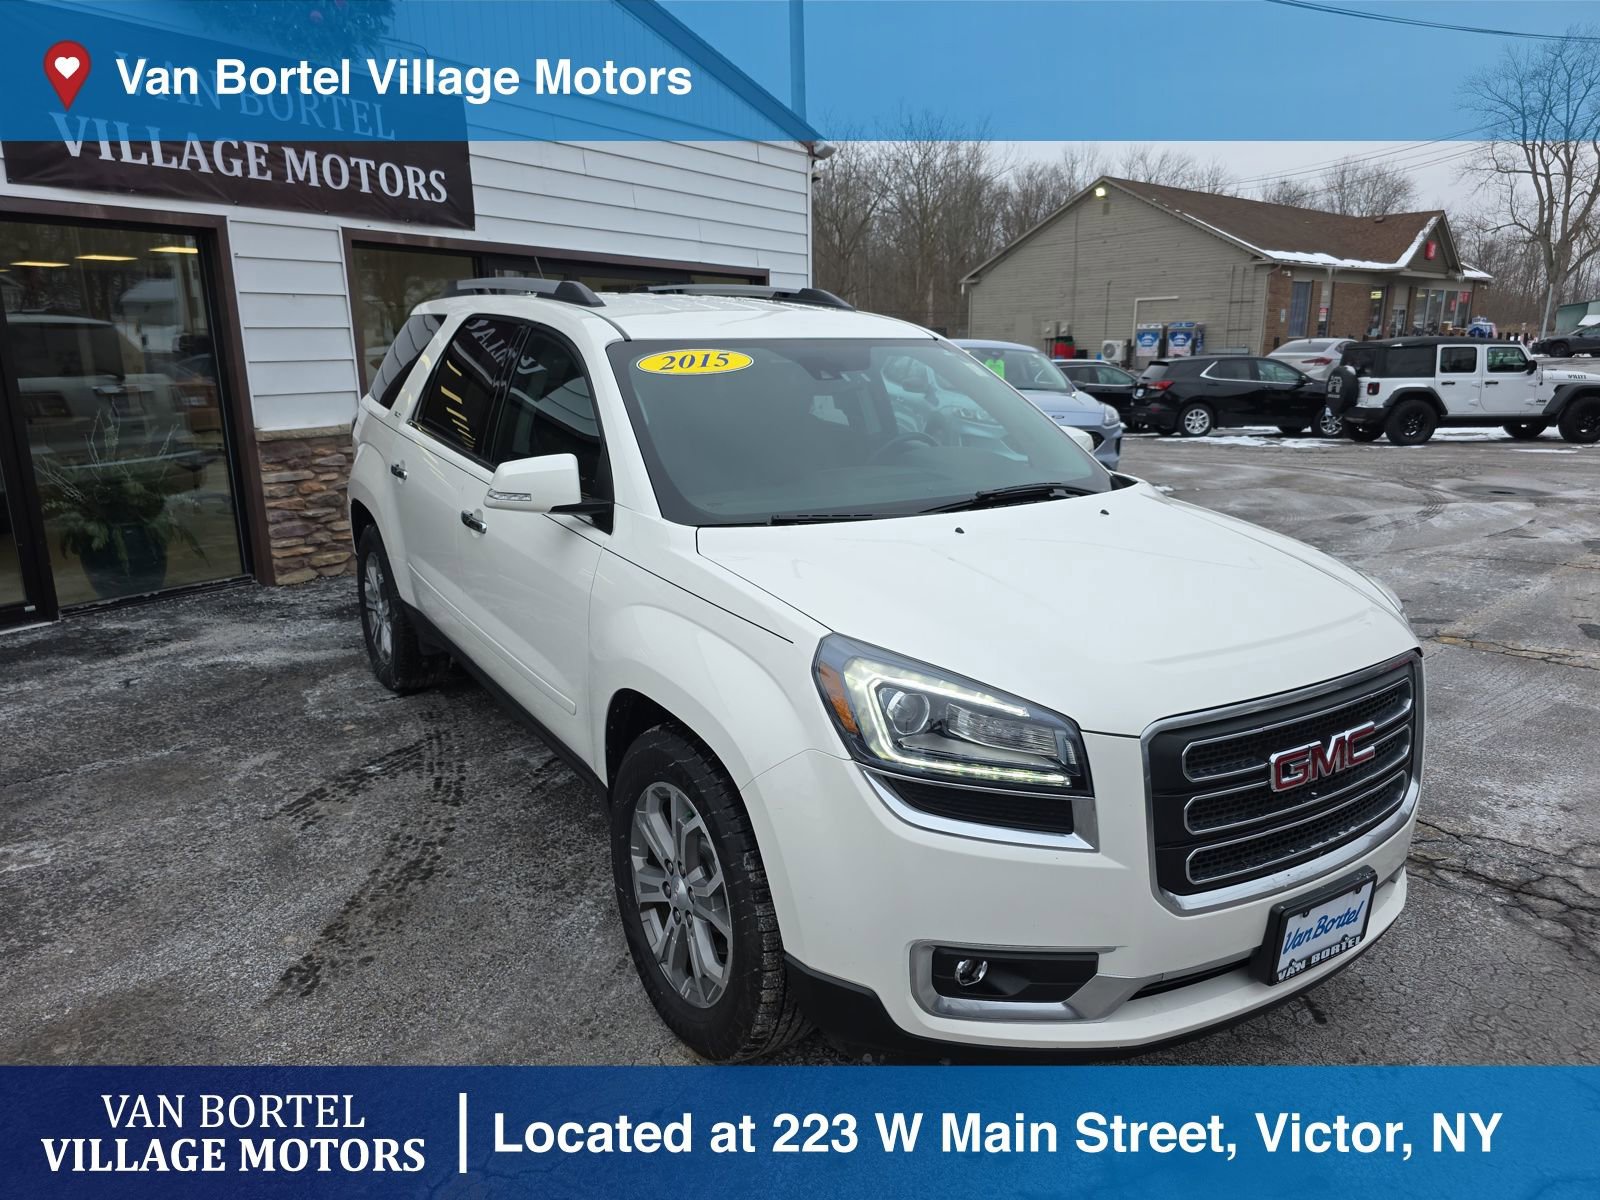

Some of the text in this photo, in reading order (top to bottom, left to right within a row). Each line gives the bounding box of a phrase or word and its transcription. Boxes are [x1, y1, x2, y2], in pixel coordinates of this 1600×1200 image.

[49, 112, 447, 203] VILLAGE MOTORS
[659, 353, 730, 371] 2015
[1269, 720, 1375, 793] GMC
[1282, 900, 1365, 955] Van Bortel
[1277, 936, 1361, 981] VAN BORTEL
